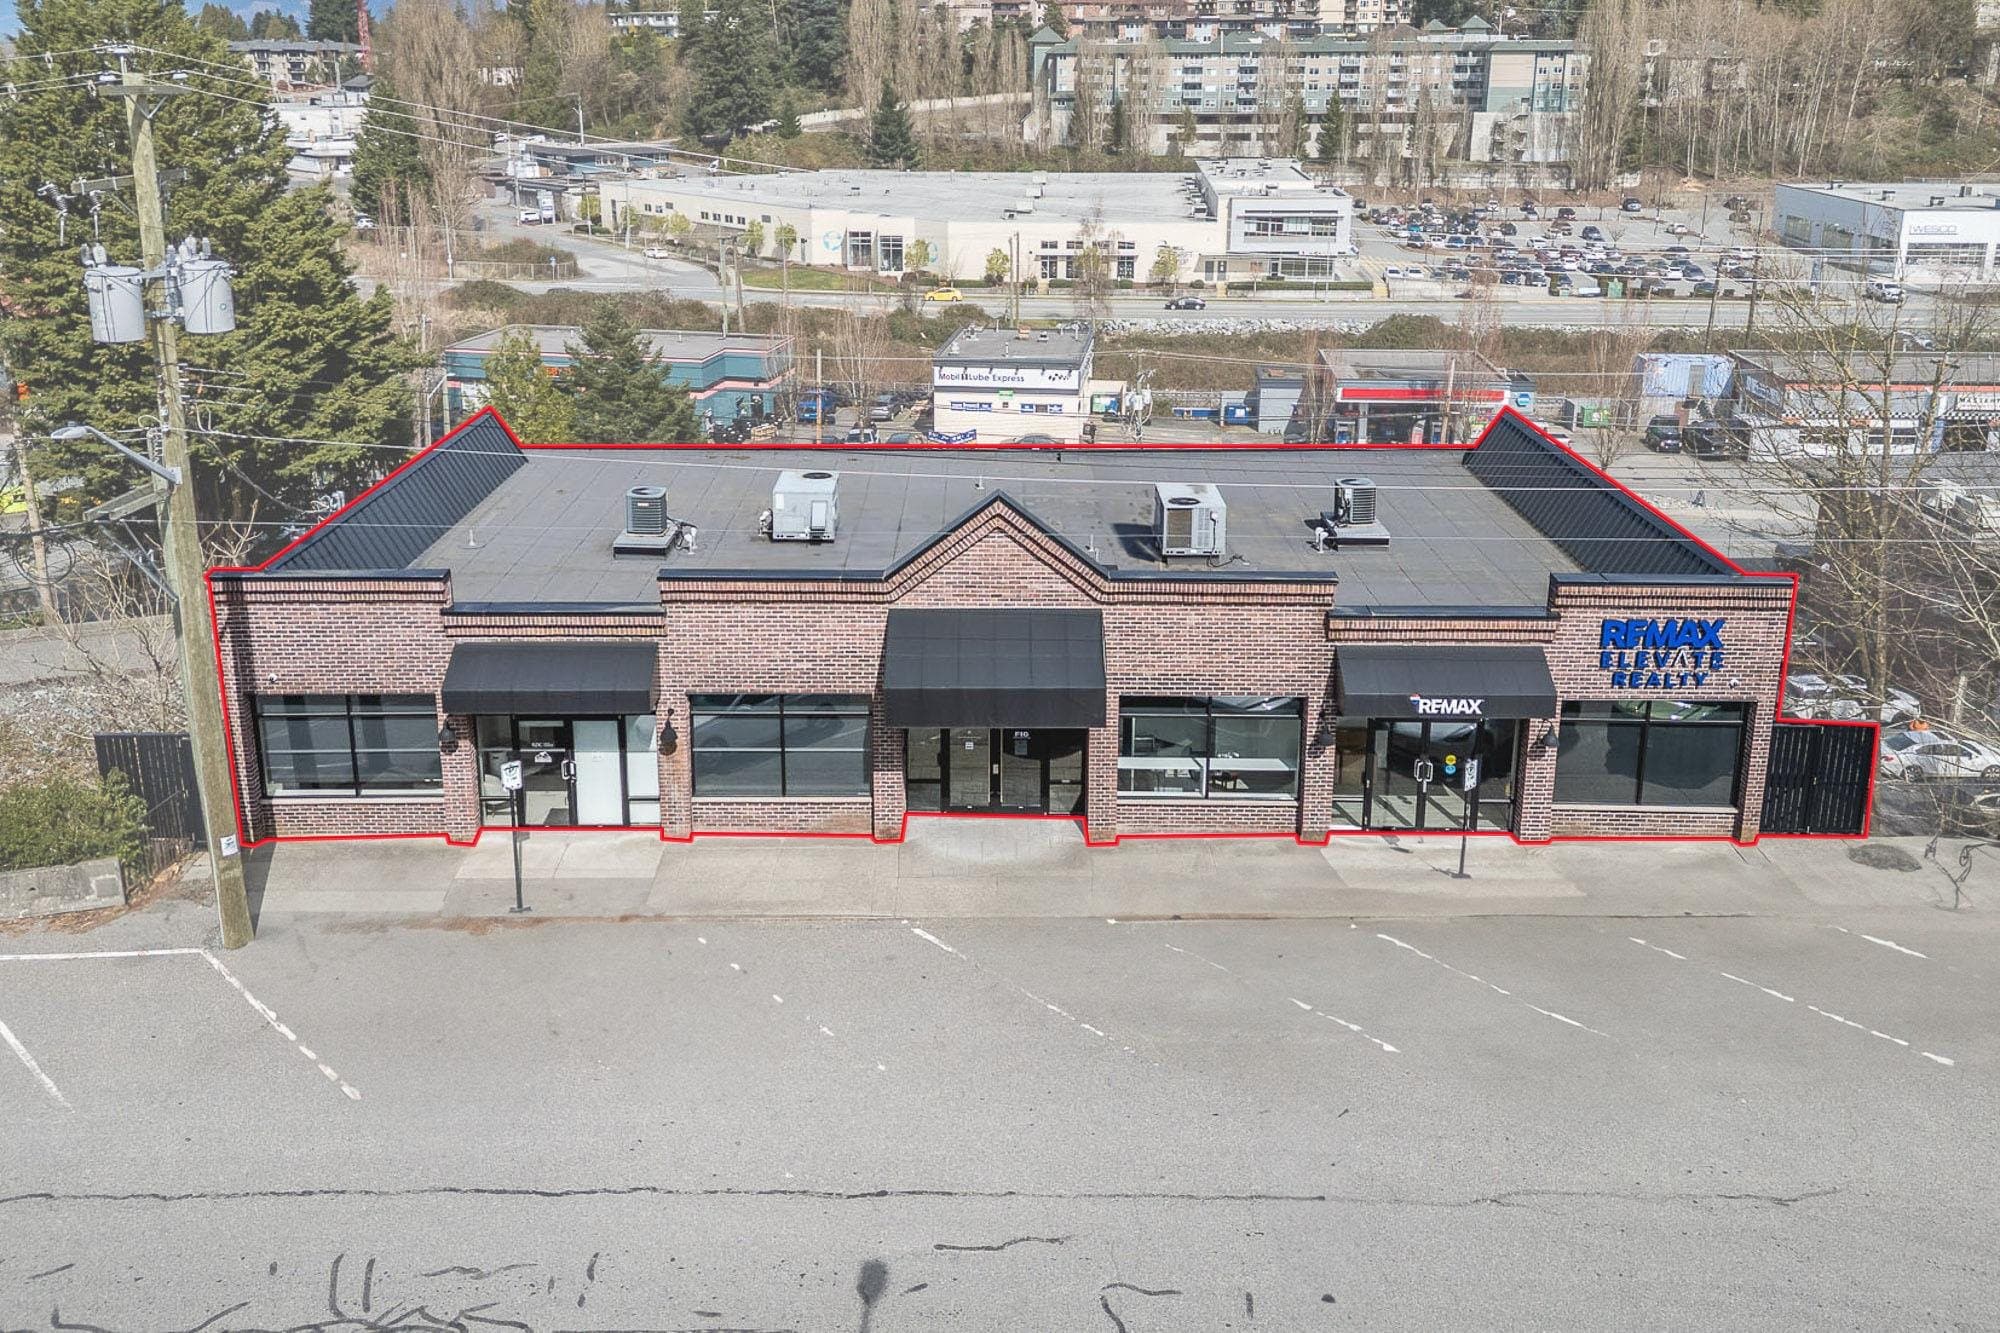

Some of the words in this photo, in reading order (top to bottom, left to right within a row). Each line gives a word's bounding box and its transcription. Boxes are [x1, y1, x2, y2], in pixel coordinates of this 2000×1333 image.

[938, 373, 960, 381] Mobil
[969, 373, 990, 382] Lube
[992, 375, 1025, 383] Express
[1600, 650, 1724, 669] ELEVATE
[1611, 671, 1708, 689] REALTY
[1418, 699, 1483, 714] REMAX
